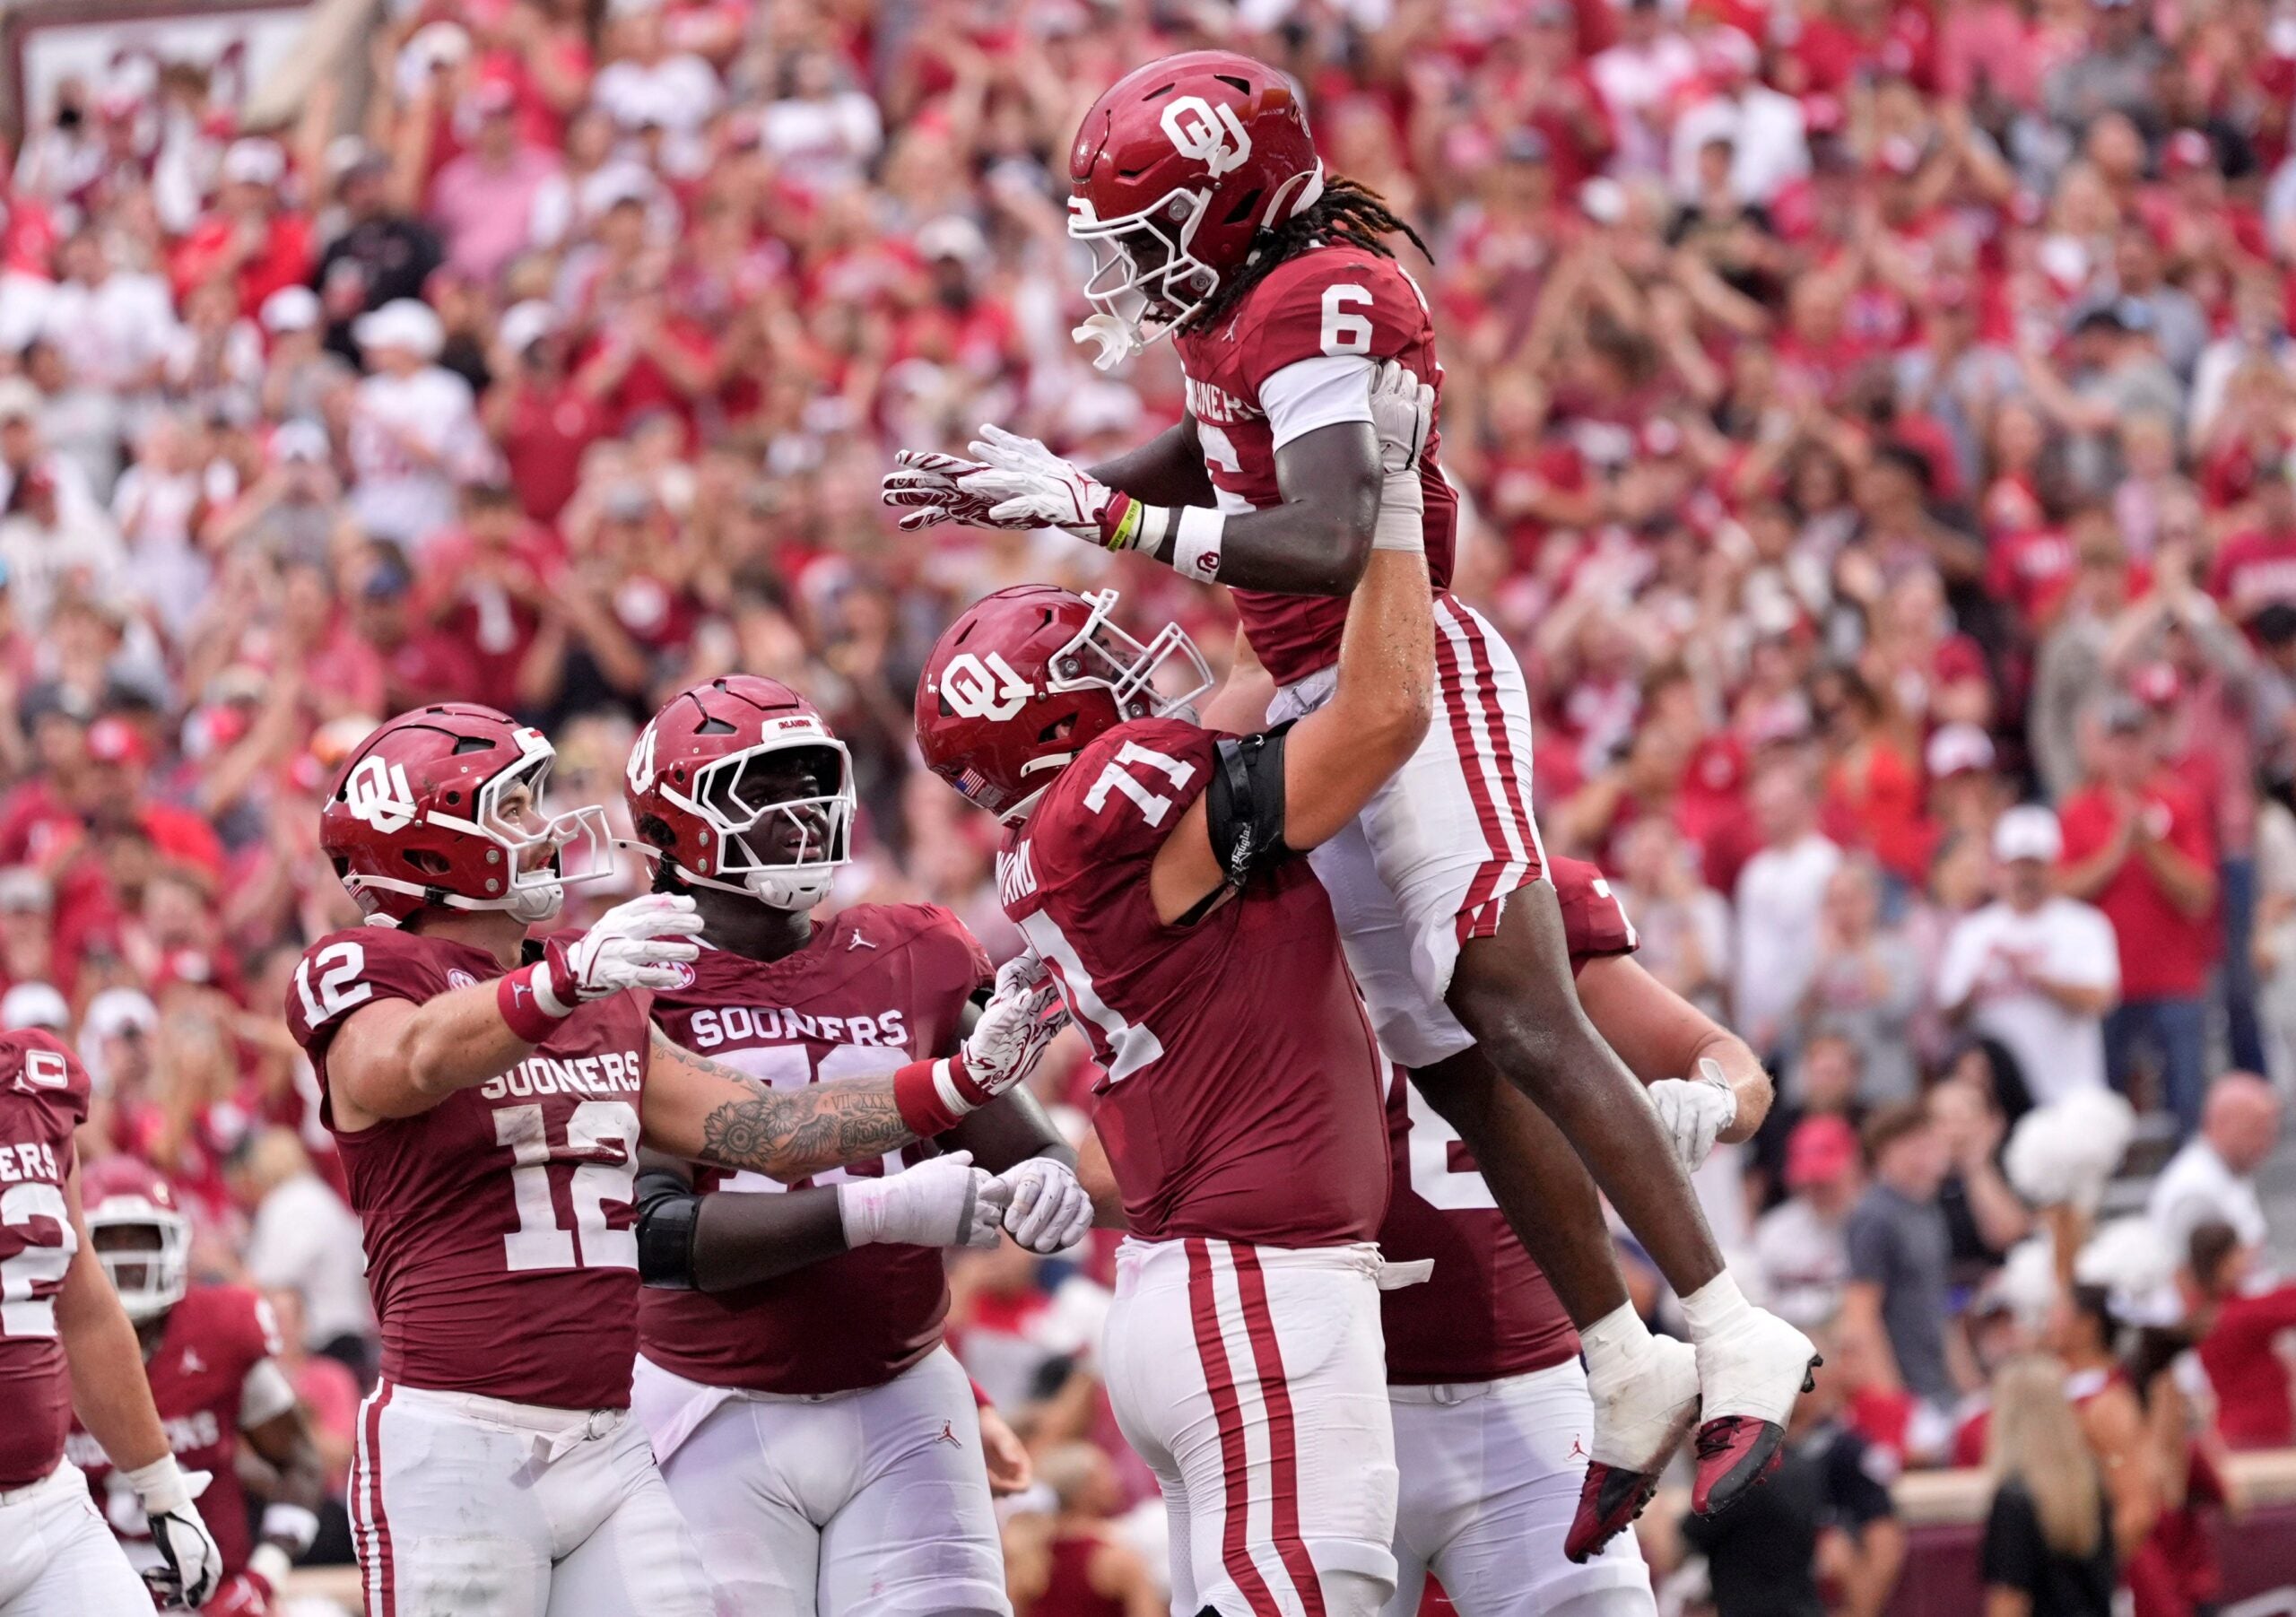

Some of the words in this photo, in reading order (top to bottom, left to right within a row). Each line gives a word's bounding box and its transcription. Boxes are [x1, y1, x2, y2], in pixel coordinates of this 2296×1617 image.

[1320, 284, 1373, 356] 6
[1083, 740, 1196, 827] 71
[294, 942, 372, 1030] 12
[690, 1006, 909, 1048] SOONERS
[28, 1052, 66, 1086] C
[481, 1050, 641, 1100] SOONERS
[492, 1101, 641, 1272] 12
[0, 1183, 78, 1338] 2
